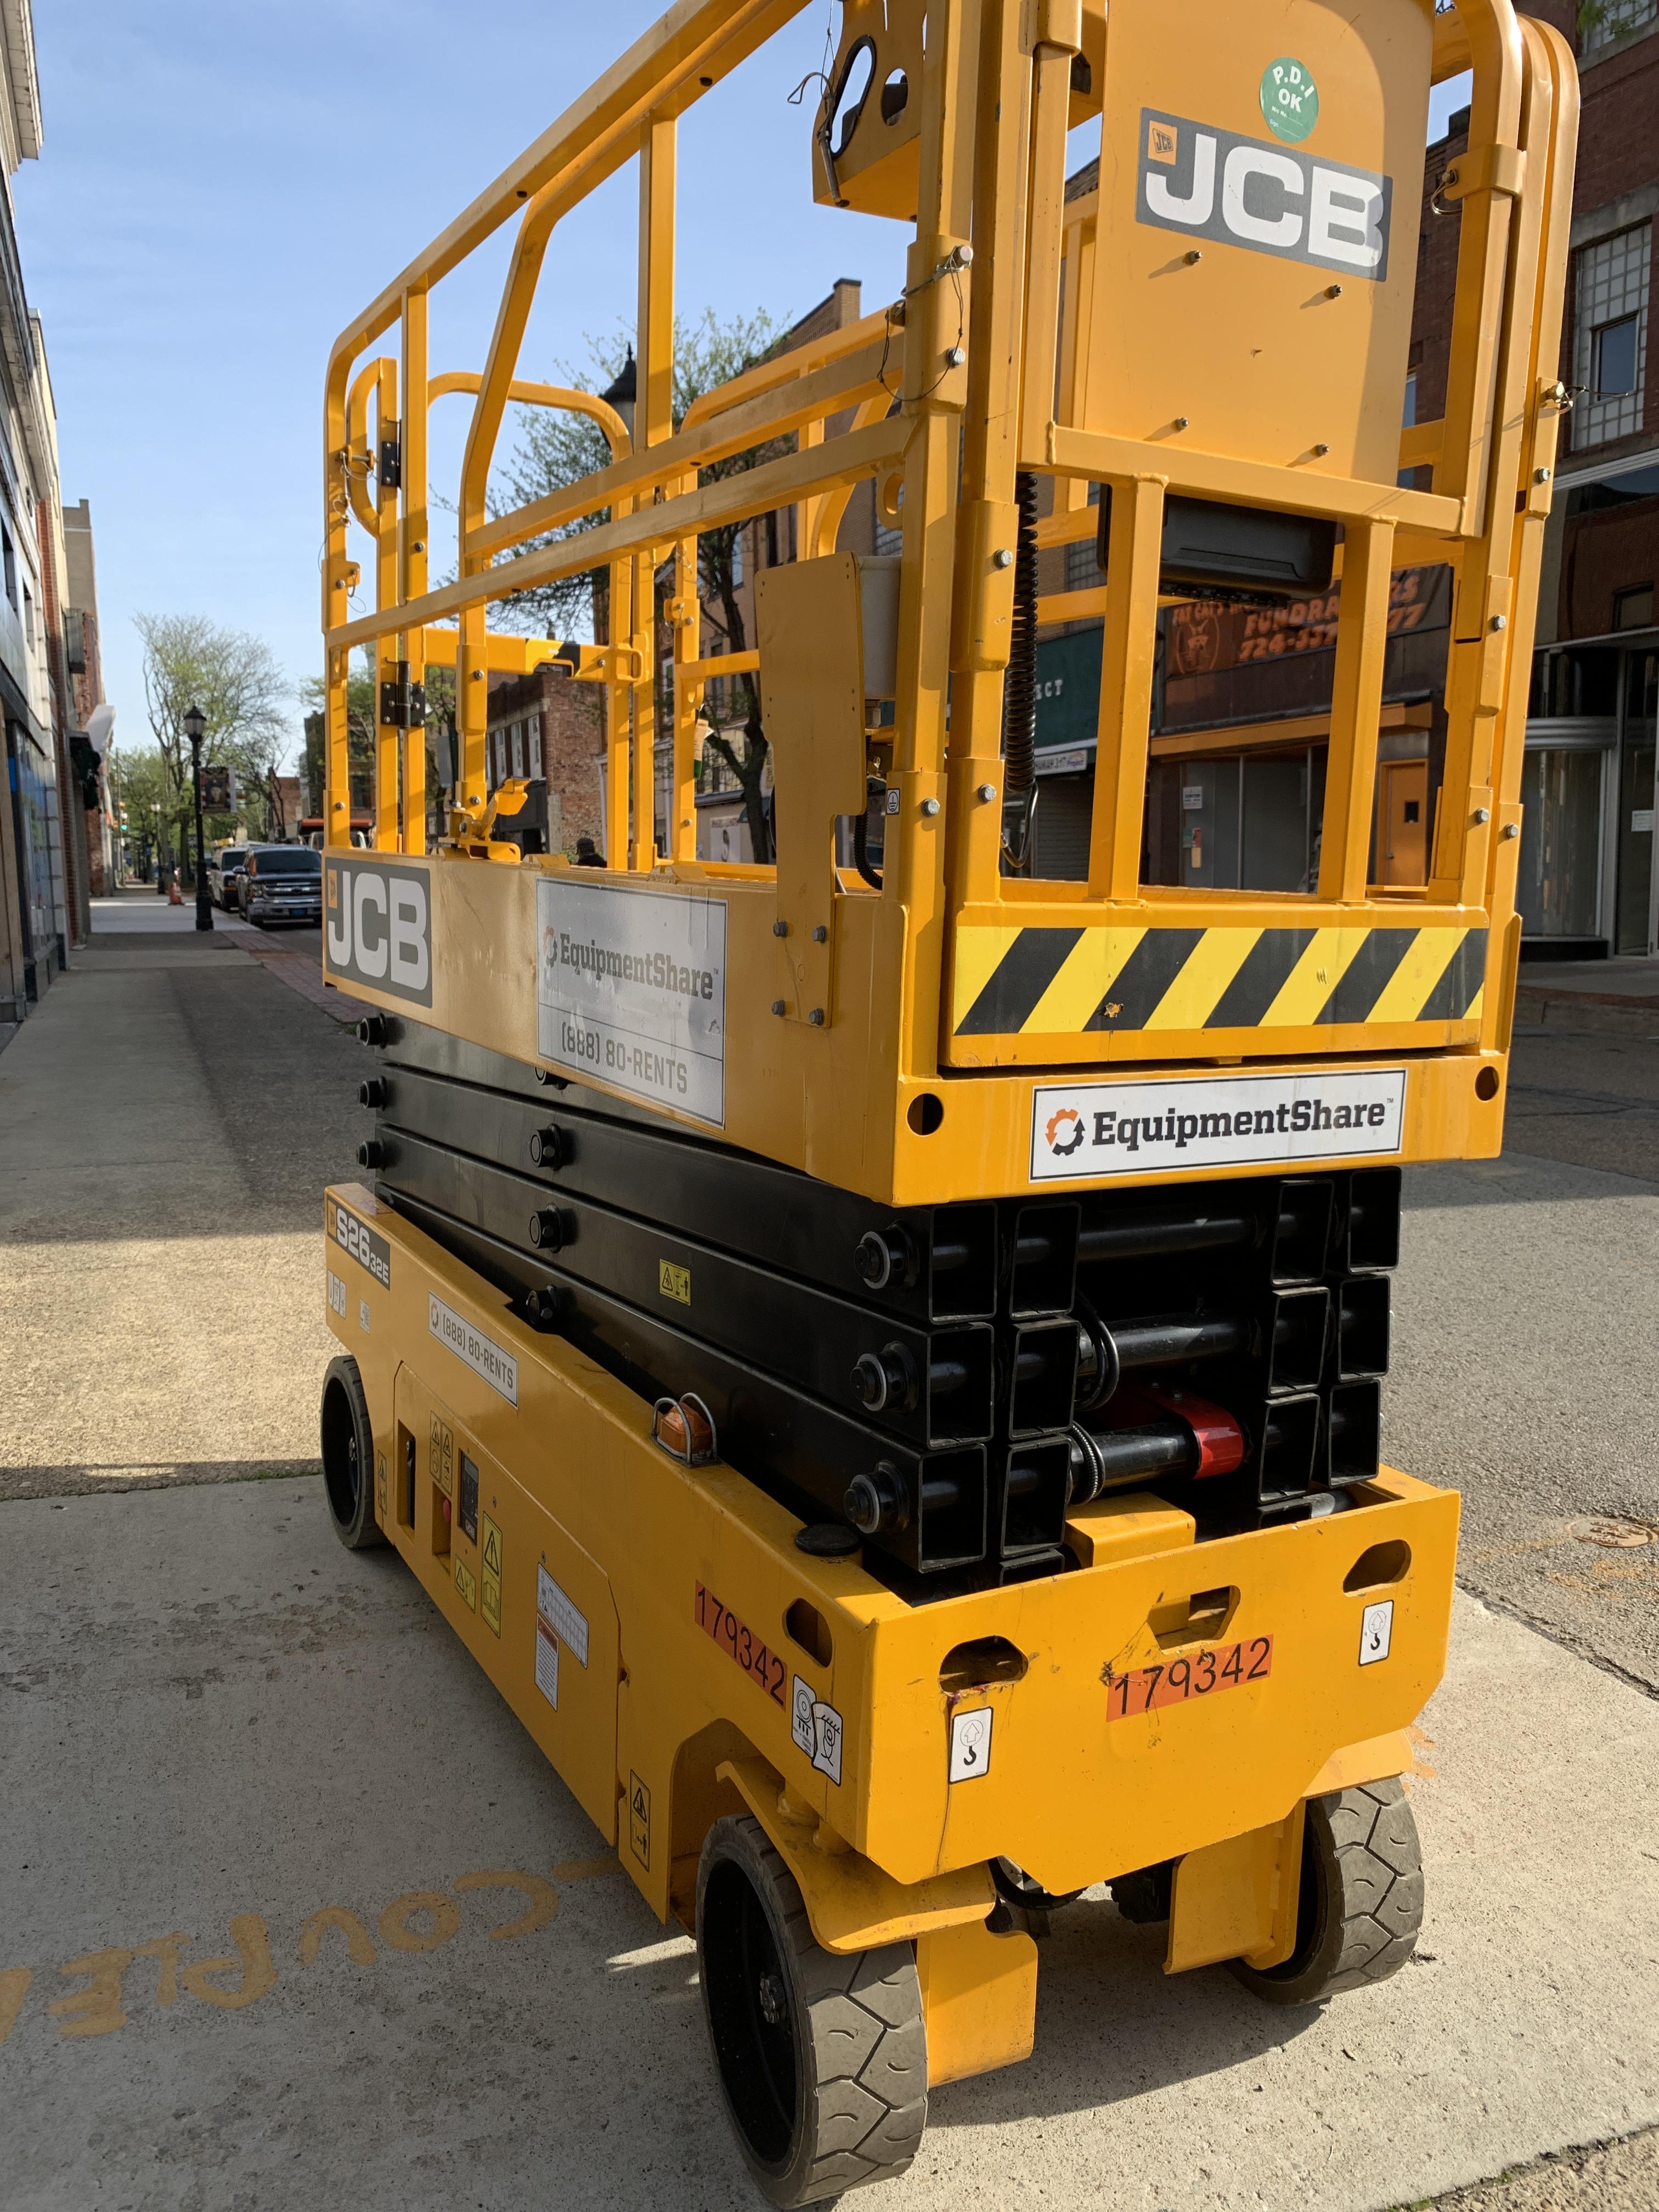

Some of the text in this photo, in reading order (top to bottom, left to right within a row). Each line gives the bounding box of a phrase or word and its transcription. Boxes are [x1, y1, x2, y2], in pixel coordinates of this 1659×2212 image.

[1278, 88, 1303, 114] OK
[1156, 132, 1172, 151] JCB
[1146, 133, 1384, 267] JCB
[328, 870, 429, 991] JCB
[560, 933, 713, 1001] EquipmentShare
[562, 1021, 687, 1094] (888) 80-RENTS
[1092, 1099, 1385, 1152] EquipmentShare
[442, 1313, 514, 1390] (888) 80-RENTS
[698, 1587, 785, 1705] 179342
[1114, 1637, 1271, 1715] 179342
